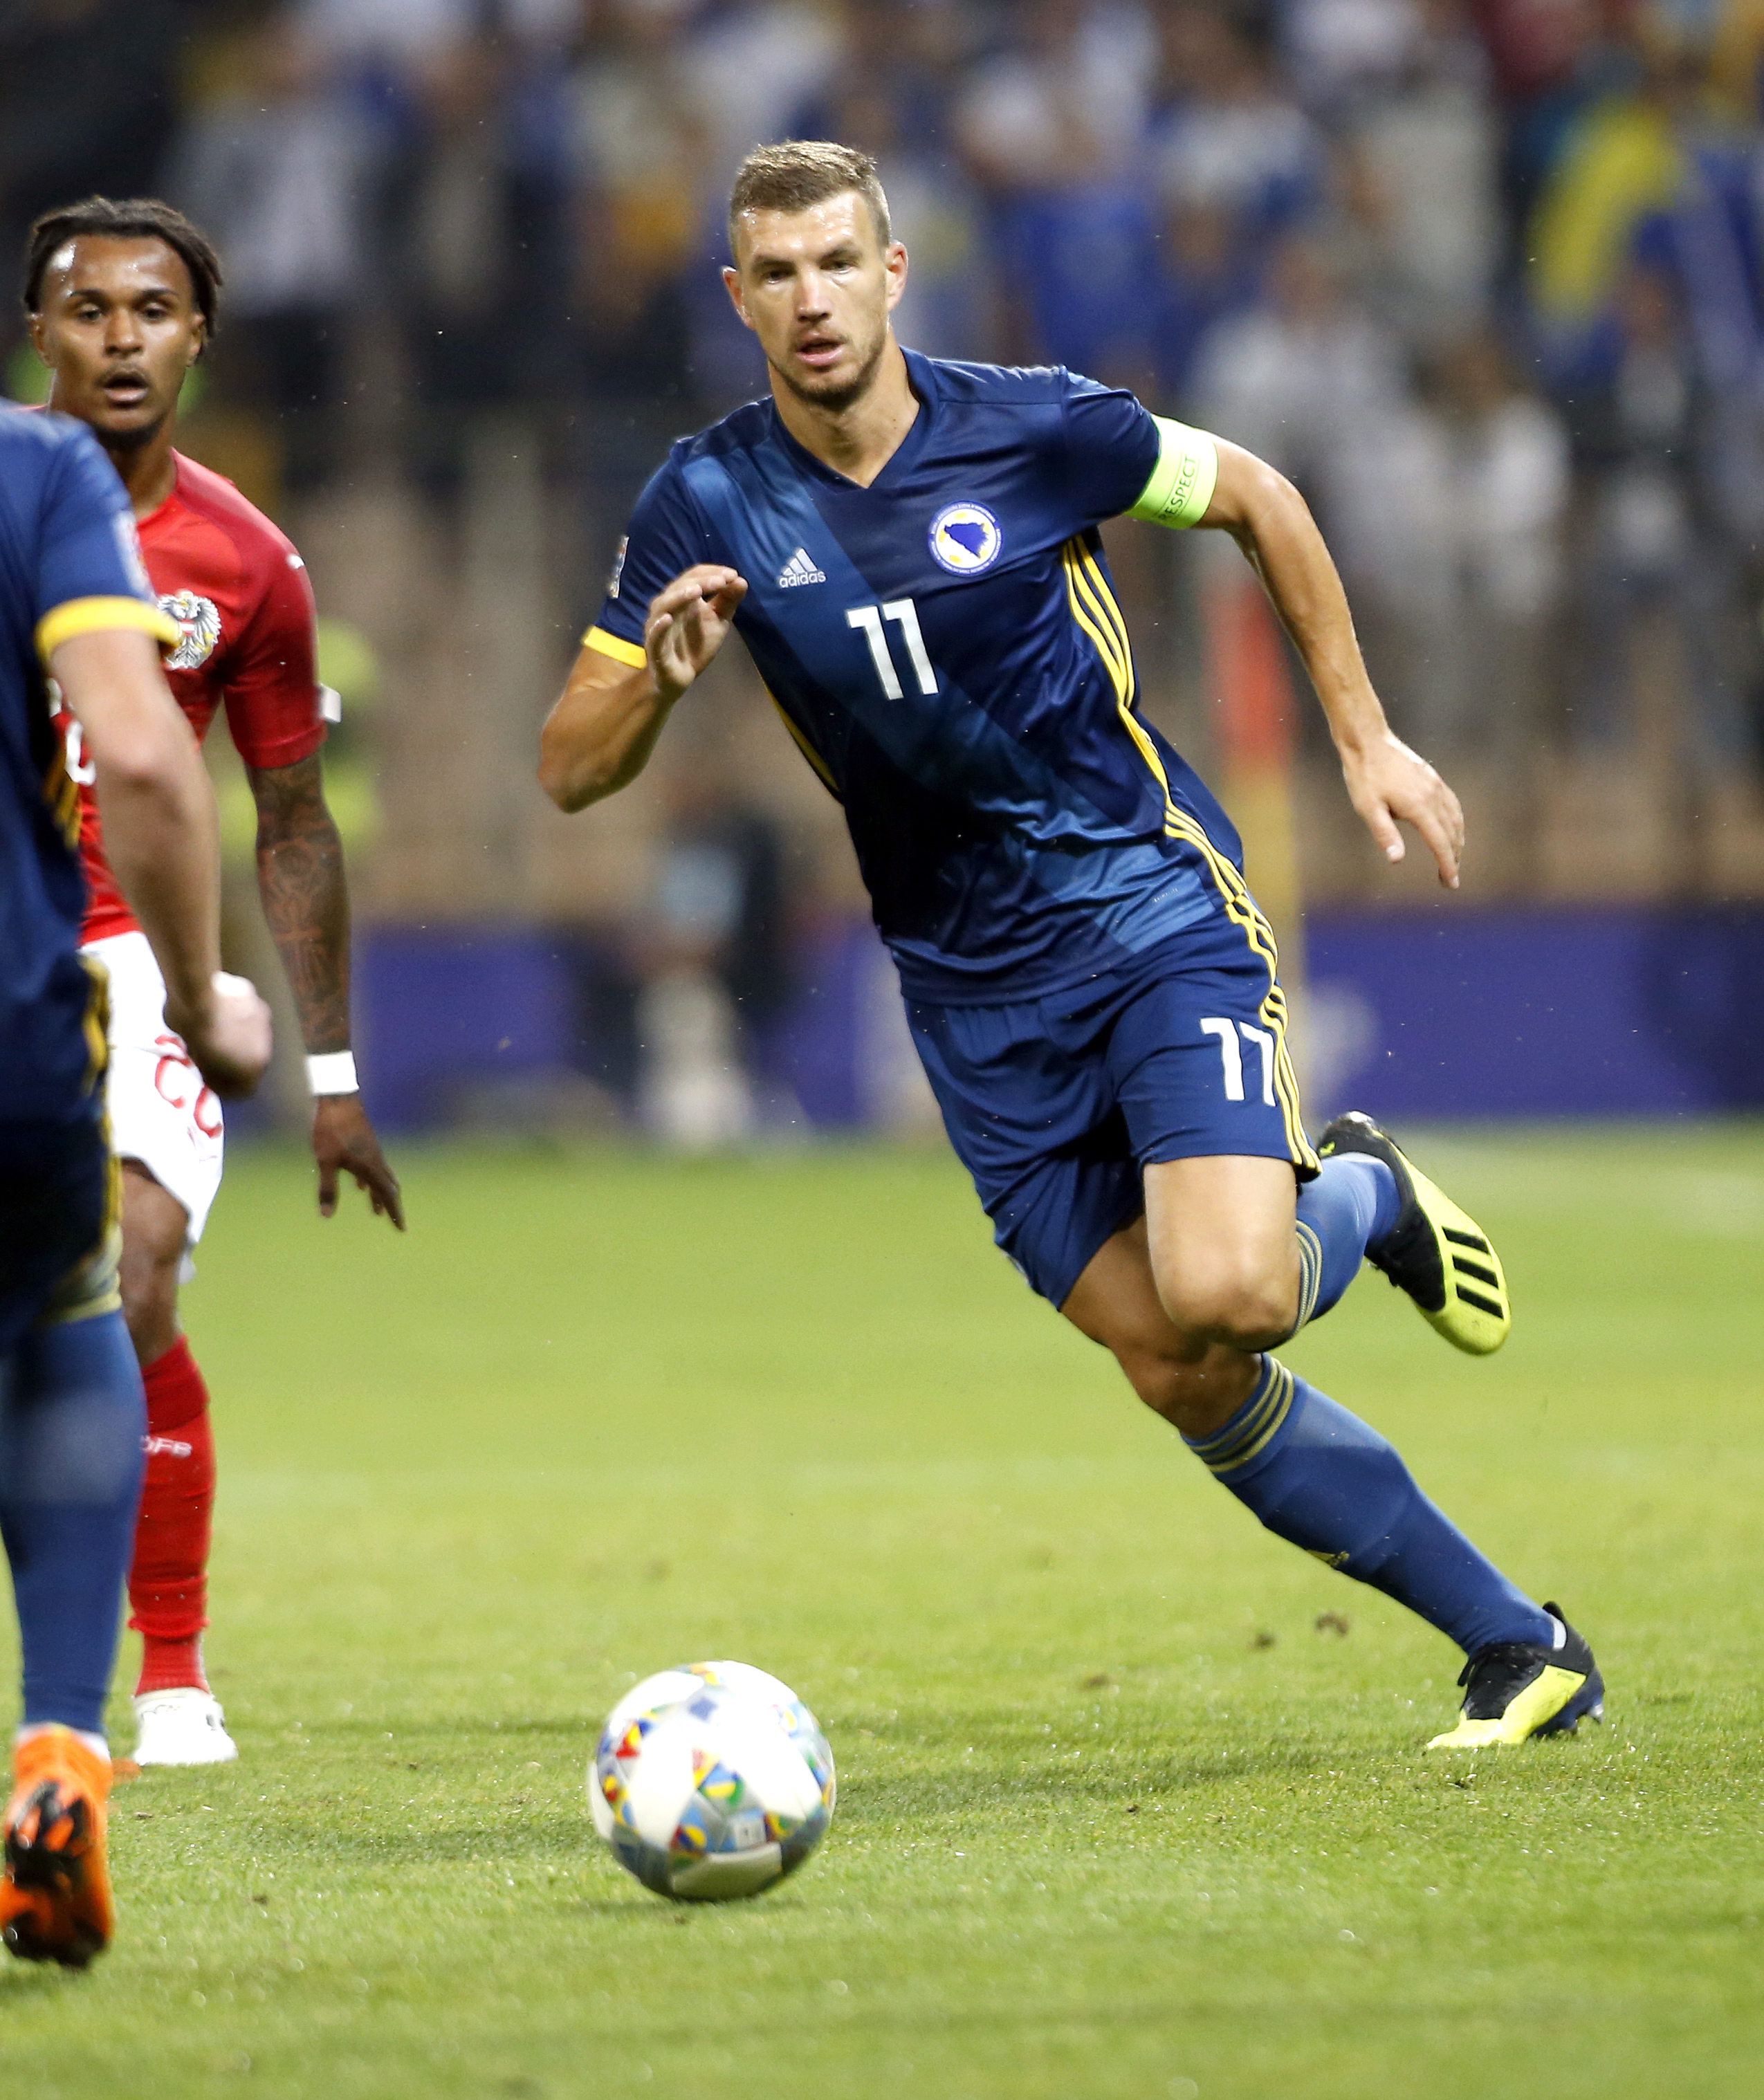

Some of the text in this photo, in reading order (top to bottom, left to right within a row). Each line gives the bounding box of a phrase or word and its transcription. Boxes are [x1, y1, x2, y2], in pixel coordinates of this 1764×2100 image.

[779, 571, 827, 588] adidas
[846, 598, 939, 700] 11
[1200, 1017, 1277, 1107] 11
